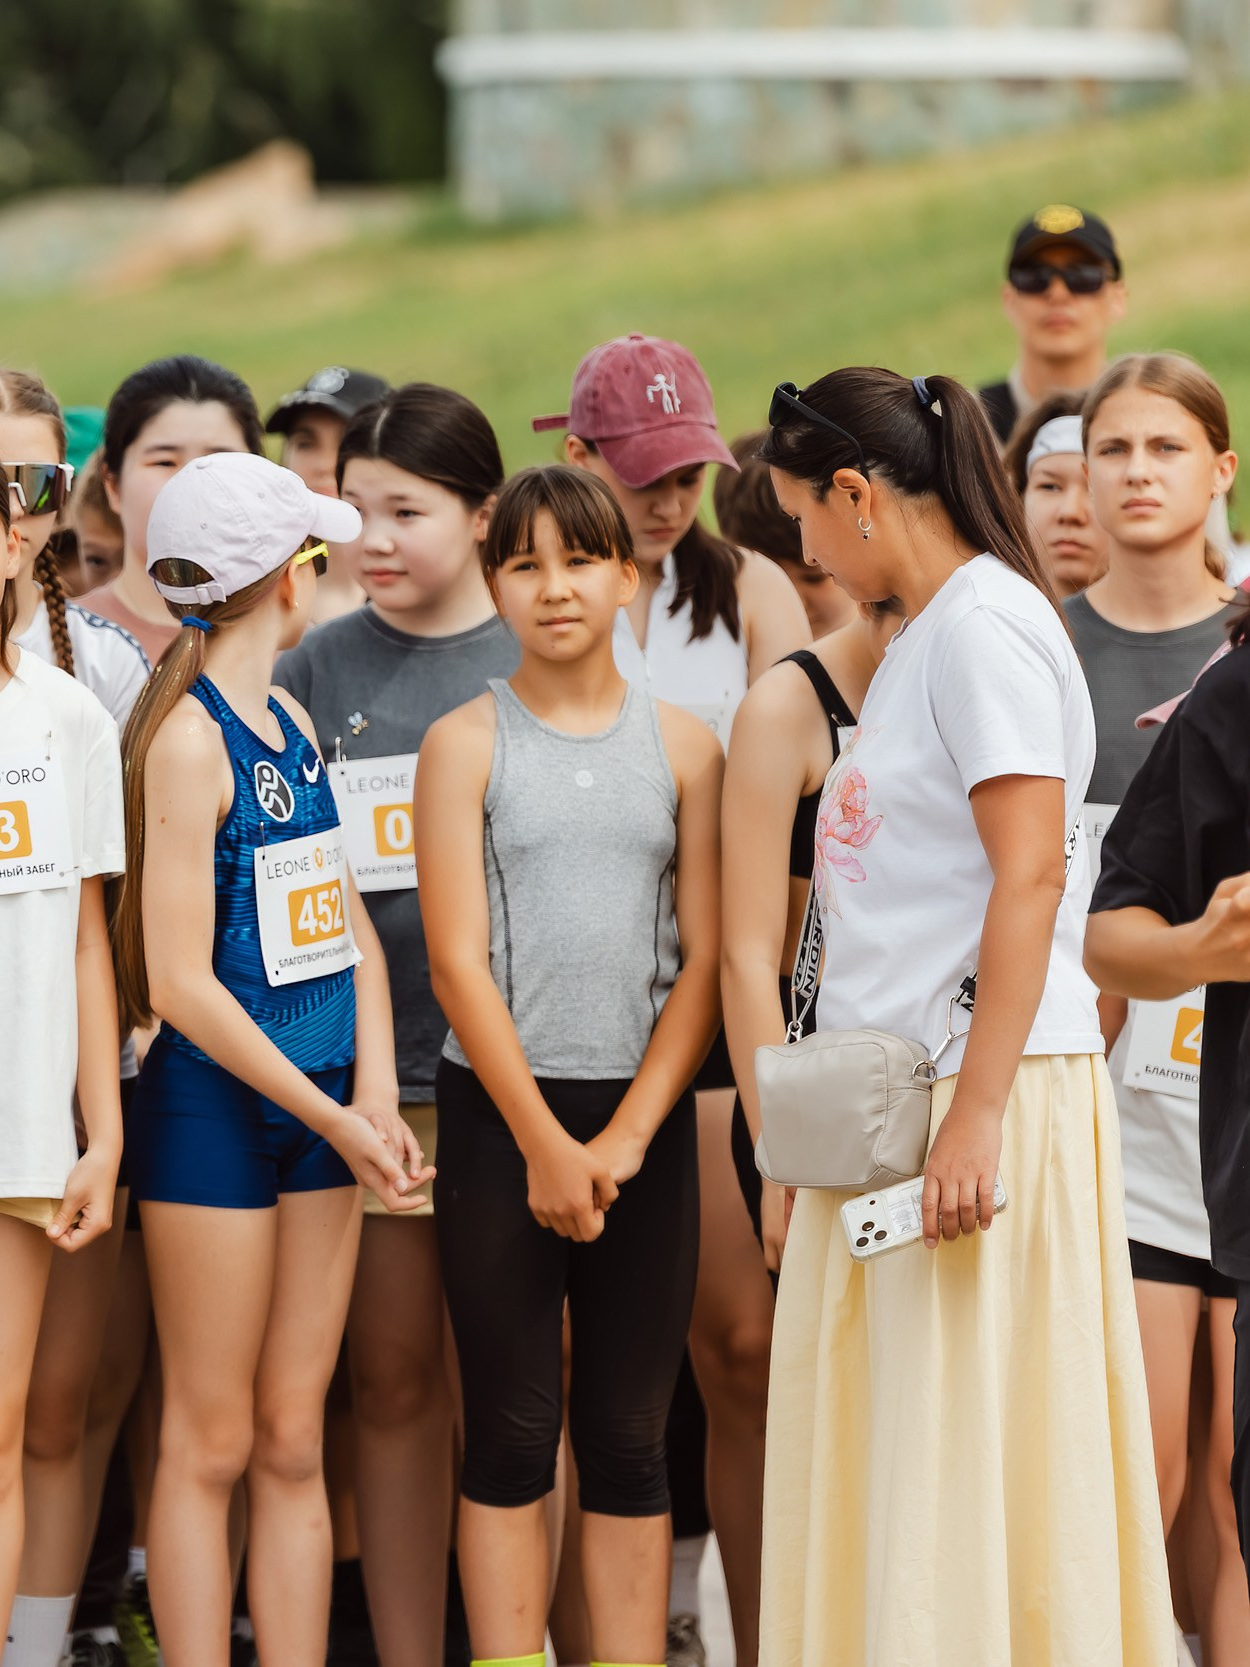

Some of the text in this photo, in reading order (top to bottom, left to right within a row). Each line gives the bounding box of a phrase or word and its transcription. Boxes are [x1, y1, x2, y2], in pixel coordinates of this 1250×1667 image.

[347, 773, 411, 794] LEONE
[385, 808, 413, 851] 0
[26, 863, 55, 876] ЗАБЕГ
[267, 857, 310, 879] LEONE
[298, 887, 344, 936] 452
